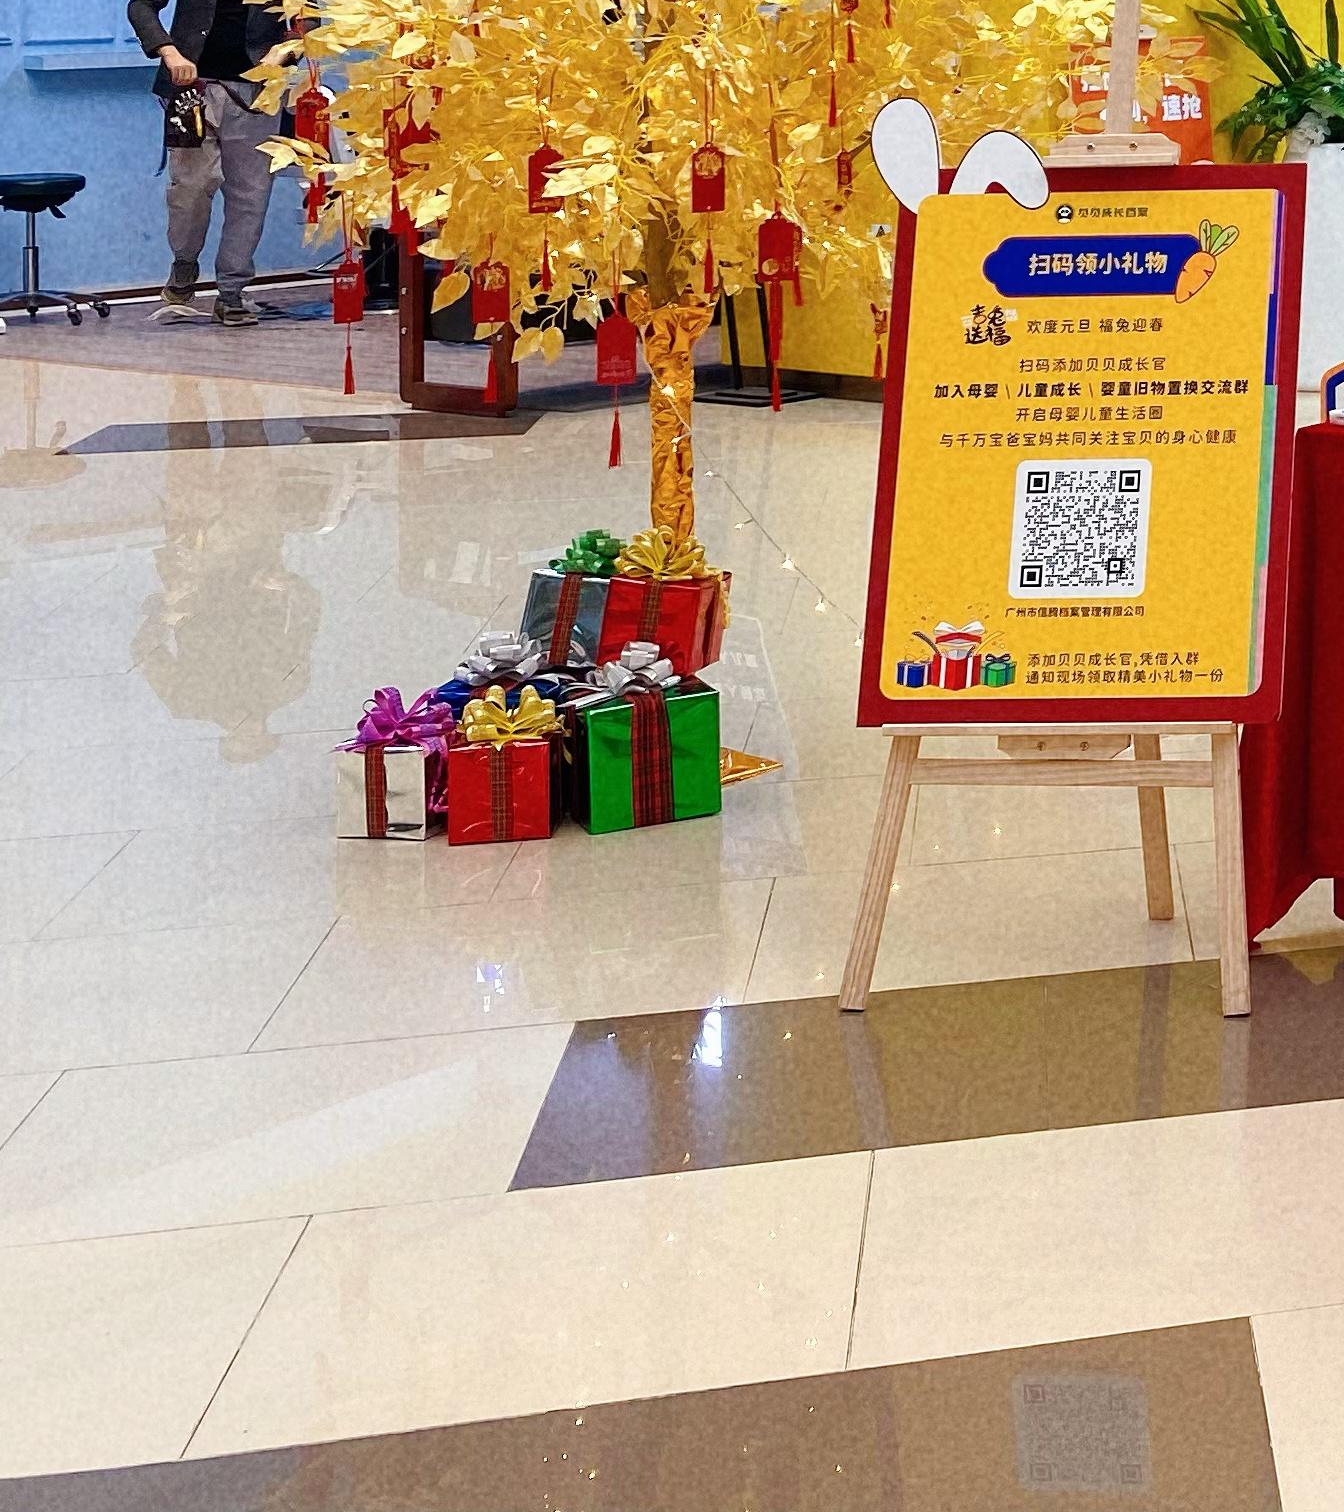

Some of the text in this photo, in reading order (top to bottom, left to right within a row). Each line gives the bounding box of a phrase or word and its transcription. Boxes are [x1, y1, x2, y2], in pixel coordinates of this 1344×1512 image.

[1028, 252, 1168, 277] 扫码领小礼物
[1027, 318, 1163, 334] 欢度元旦 福兔迎春
[1019, 357, 1166, 373] 扫码添加贝贝成长官
[933, 383, 999, 399] 加入母婴
[1017, 382, 1082, 398] 儿童成长
[1015, 406, 1164, 422] 开启母婴儿童生活圈
[939, 429, 1237, 448] 与千万宝爸宝妈共同关注宝贝的身心健康
[1025, 668, 1224, 684] 通知现场领取精美小礼物一份
